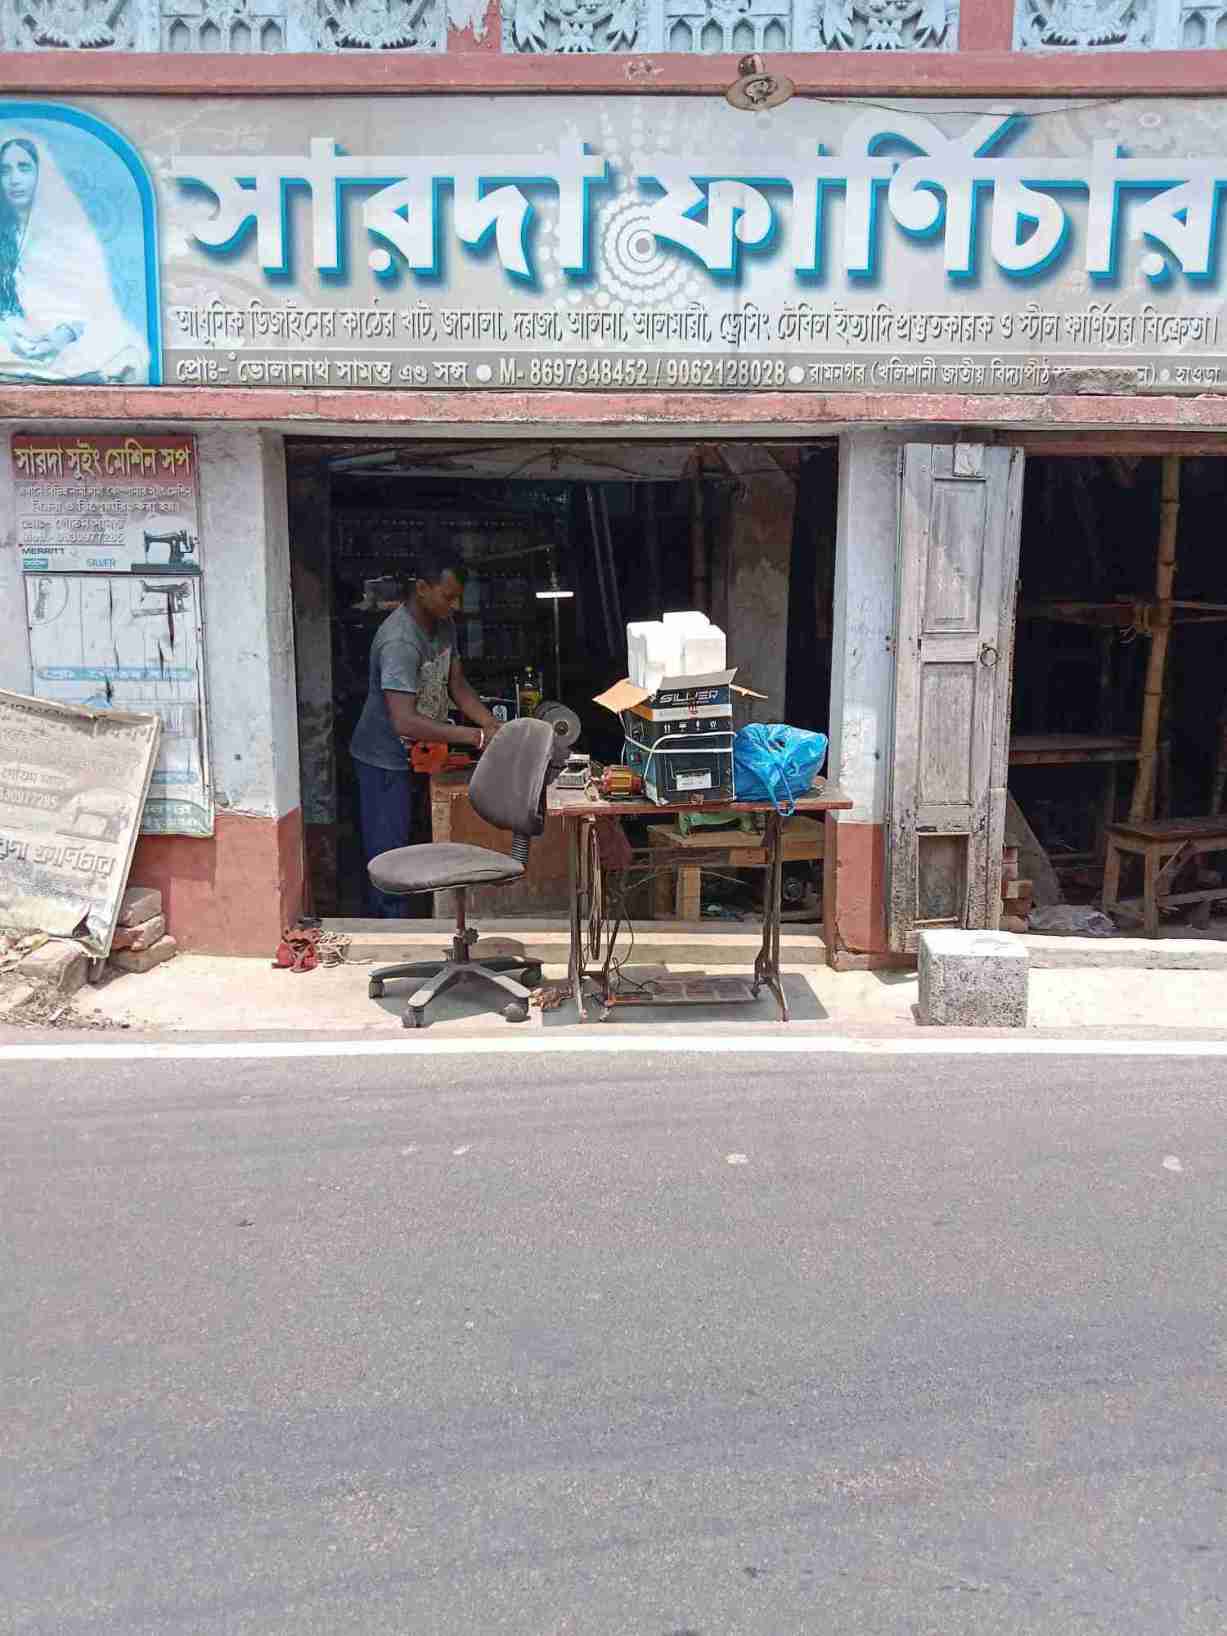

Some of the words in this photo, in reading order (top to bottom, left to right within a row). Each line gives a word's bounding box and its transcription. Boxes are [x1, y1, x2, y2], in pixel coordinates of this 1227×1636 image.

[170, 137, 606, 275] সারদা
[174, 299, 245, 348] আধুনিক
[250, 298, 336, 341] ডিজাইনের
[340, 299, 395, 338] কাঠের
[400, 300, 437, 342] খাট,
[514, 309, 563, 341] দরজা,
[567, 308, 628, 341] আলনা,
[632, 301, 712, 342] আলমারী,
[720, 303, 770, 347] ড্রেসিং
[778, 301, 830, 343] টেবিল
[833, 301, 895, 345] ইত্যাদি
[1000, 313, 1014, 339] ও
[333, 356, 392, 384] সামন্ত
[530, 358, 648, 385] 8697348452
[667, 359, 785, 387] 9062128028
[808, 361, 865, 385] রামনগর
[14, 444, 65, 477] সারদা
[105, 438, 157, 476] মেশিন
